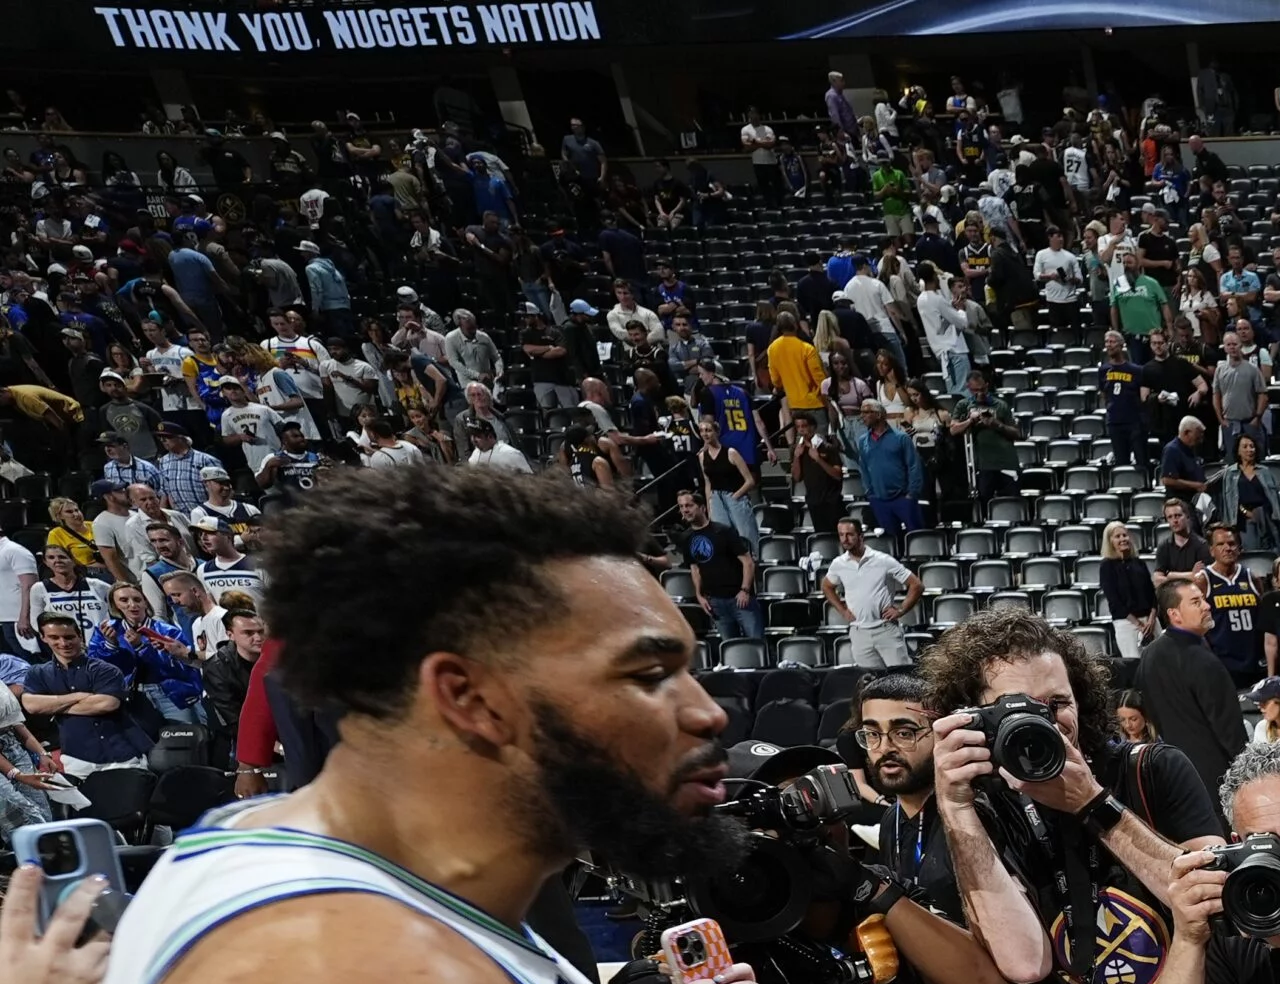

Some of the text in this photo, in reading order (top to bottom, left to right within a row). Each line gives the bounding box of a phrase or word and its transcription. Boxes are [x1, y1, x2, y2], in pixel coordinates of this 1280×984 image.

[95, 7, 240, 51] THANK
[323, 5, 475, 49] NUGGETS
[477, 1, 601, 43] NATION
[1066, 158, 1081, 174] 27
[724, 409, 747, 431] 15
[672, 435, 691, 452] 27
[208, 578, 252, 589] WOLVES
[52, 602, 102, 613] WOLVES
[1213, 593, 1257, 609] DENVER
[1228, 609, 1253, 631] 50
